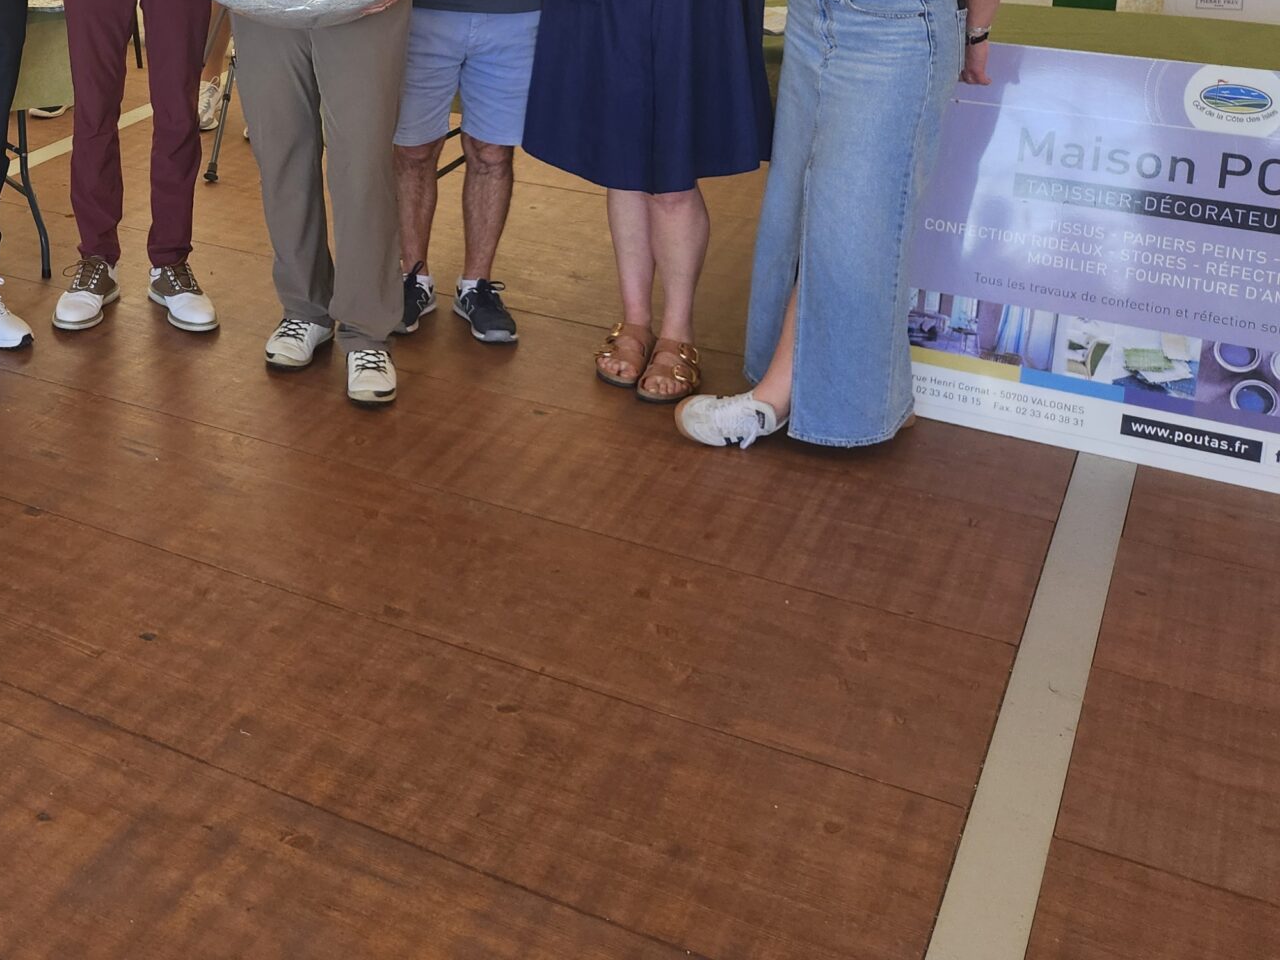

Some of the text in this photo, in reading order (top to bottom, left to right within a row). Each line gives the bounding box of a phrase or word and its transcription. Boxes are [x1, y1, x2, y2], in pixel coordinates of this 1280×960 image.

[1205, 109, 1215, 118] de
[1216, 112, 1224, 121] la
[1225, 114, 1245, 124] Côte
[1017, 126, 1196, 186] Maison
[924, 217, 1025, 245] CONFECTION
[1031, 233, 1103, 257] RIDEAUX
[1120, 248, 1187, 271] STORES
[1048, 219, 1106, 241] TISSUS
[1123, 231, 1196, 254] PAPIERS
[1202, 243, 1268, 265] PEINTS
[1027, 251, 1108, 277] MOBILIER
[1125, 266, 1240, 298] FOURNITURE
[974, 271, 1280, 335] Tous les travaux de confection et réfection so
[916, 385, 927, 395] 02
[929, 388, 940, 397] 33
[943, 391, 954, 400] 40
[958, 394, 968, 403] 18
[1016, 406, 1027, 416] 02
[1030, 408, 1041, 418] 33
[1044, 412, 1056, 421] 40
[1073, 417, 1084, 427] 31
[930, 376, 956, 389] Henri
[958, 382, 990, 395] Cornat
[1000, 390, 1028, 403] 50700
[1031, 396, 1085, 415] VALOGNES
[1131, 421, 1249, 454] www.poutas.fr
